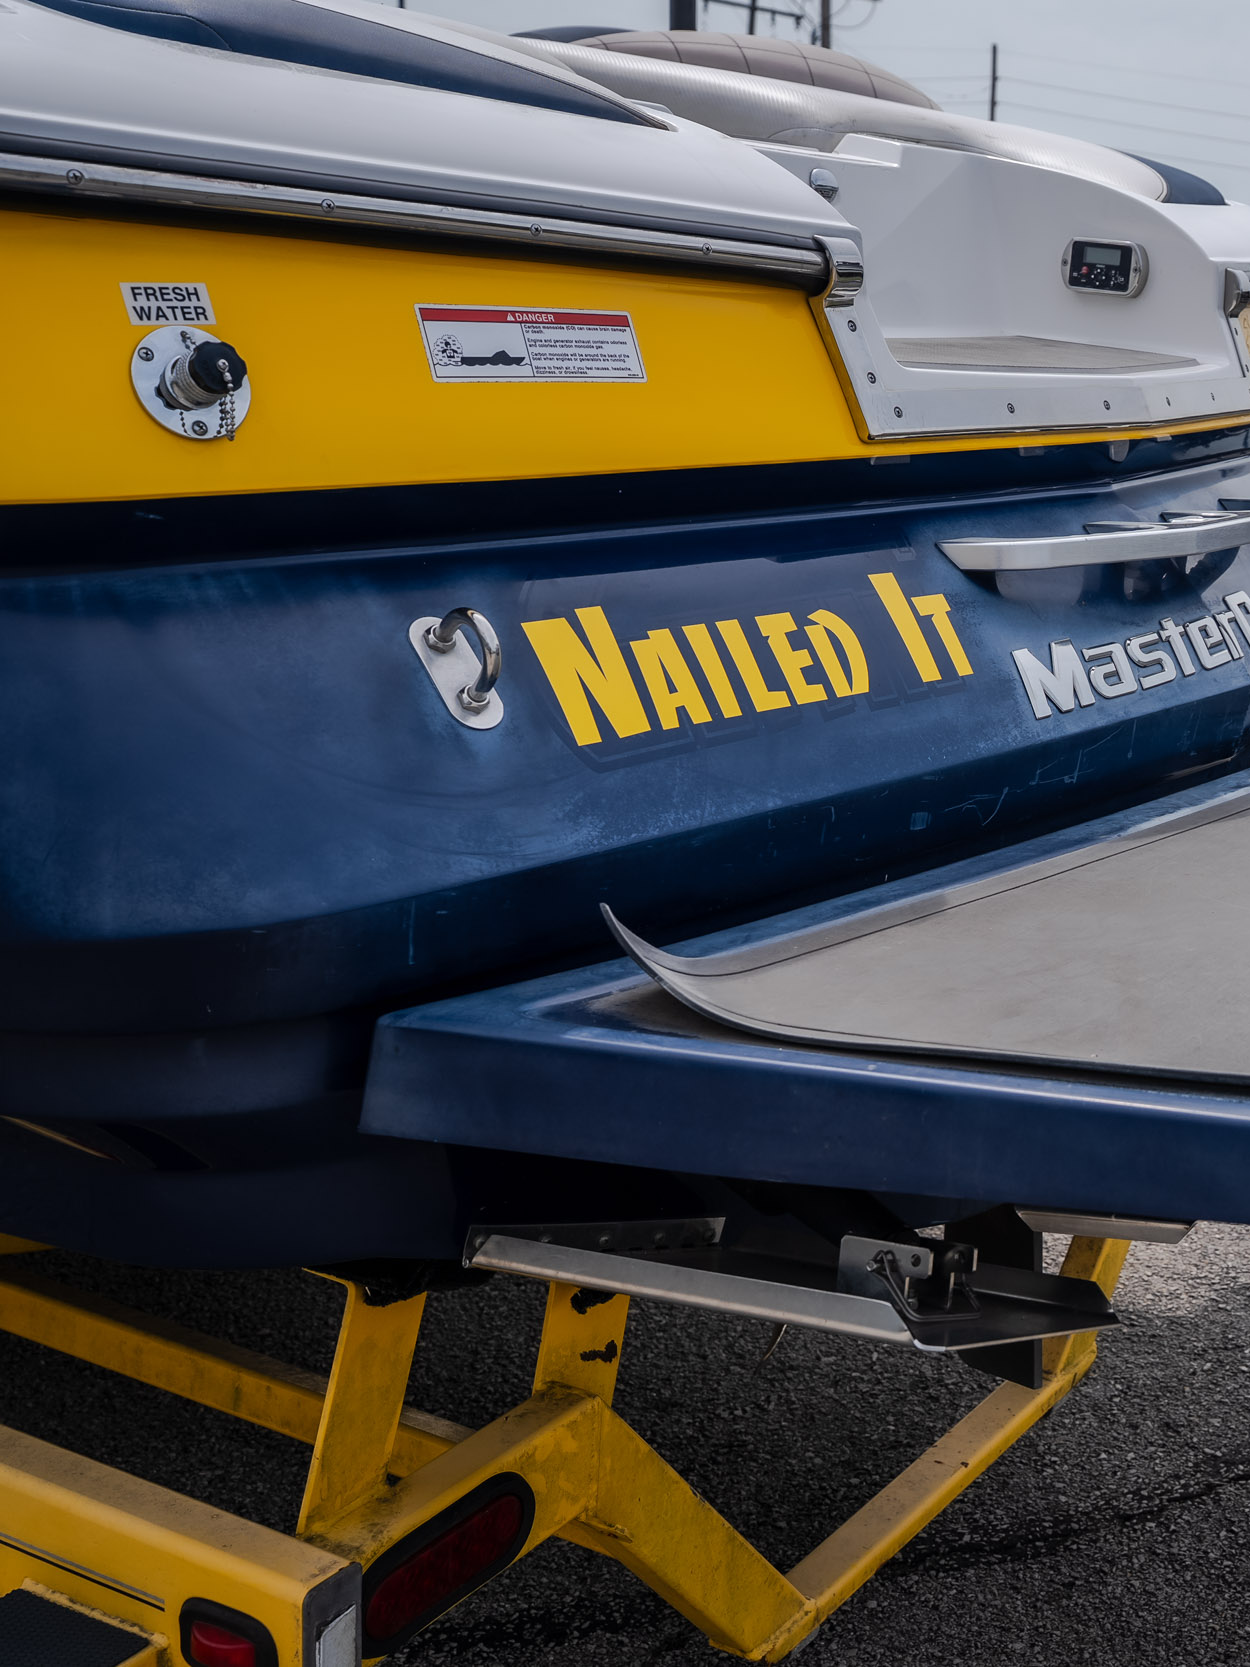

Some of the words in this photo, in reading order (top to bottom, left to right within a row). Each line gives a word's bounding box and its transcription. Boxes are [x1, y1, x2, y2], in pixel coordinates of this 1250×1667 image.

[130, 286, 201, 302] FRESH
[132, 305, 209, 321] WATER
[515, 312, 555, 323] DANGER
